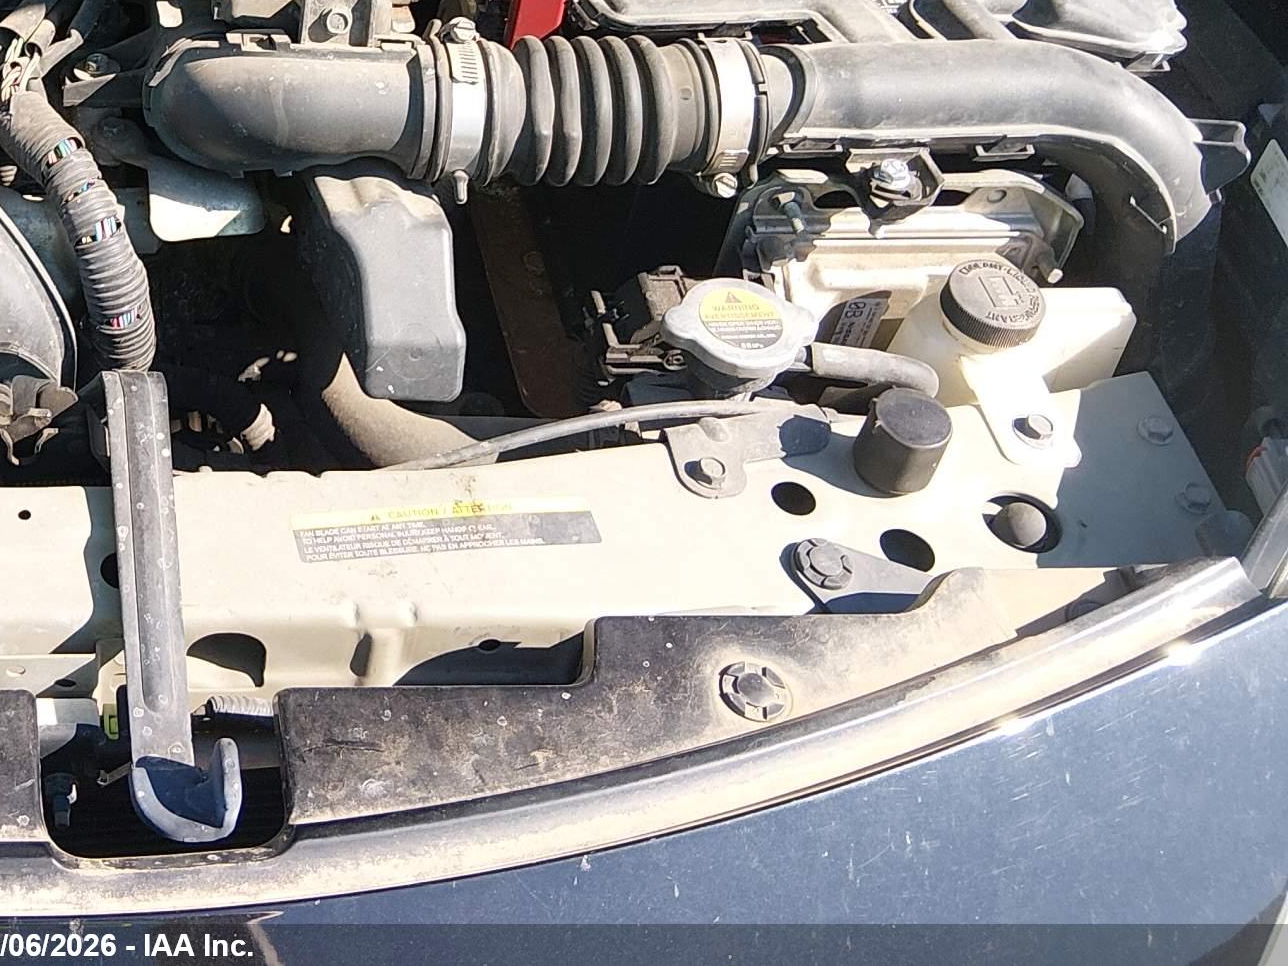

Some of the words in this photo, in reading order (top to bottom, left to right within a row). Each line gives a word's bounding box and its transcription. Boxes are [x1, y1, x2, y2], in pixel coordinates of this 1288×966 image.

[711, 304, 760, 312] WARNING
[388, 508, 439, 519] CAUTION
[300, 530, 314, 538] FAN
[316, 528, 339, 537] BLADE
[340, 527, 356, 535] CAN
[303, 537, 312, 545] TO
[313, 536, 333, 545] HELP
[334, 534, 356, 543] AVOID
[357, 531, 395, 541] PERSONAL
[304, 546, 314, 554] LE
[315, 543, 361, 553] VENTILATEUR
[363, 541, 390, 550] RISQUE
[391, 540, 401, 548] DE
[451, 534, 471, 542] TOUT
[307, 553, 328, 562] POUR
[461, 539, 505, 549] APPROCHER
[505, 538, 519, 546] LES
